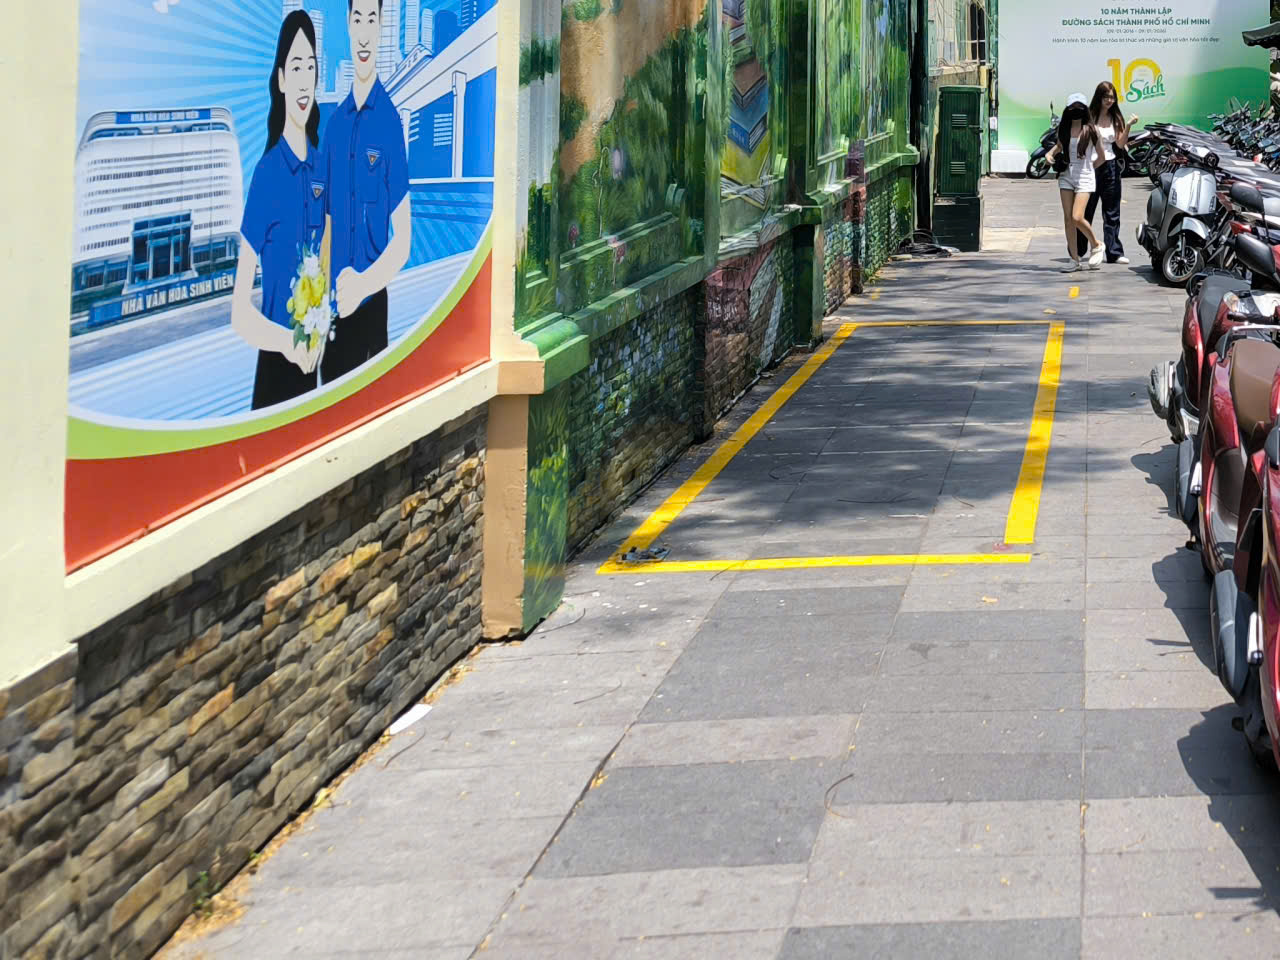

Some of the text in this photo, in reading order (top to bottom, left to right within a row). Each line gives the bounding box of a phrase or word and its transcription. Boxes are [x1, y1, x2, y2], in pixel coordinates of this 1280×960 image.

[1062, 17, 1092, 26] ĐƯỜNG
[1093, 17, 1115, 26] SÁCH
[1116, 17, 1142, 26] THÀNH
[1144, 16, 1161, 25] PHỐ
[1175, 16, 1189, 25] CHÍ
[1111, 6, 1129, 15] NĂM
[1130, 6, 1157, 15] THÀNH
[1158, 6, 1172, 17] LẬP
[1126, 74, 1166, 103] Sách
[122, 293, 144, 316] NHÀ
[146, 289, 167, 309] VĂN
[189, 280, 212, 296] SINH
[213, 273, 234, 291] VIÊN
